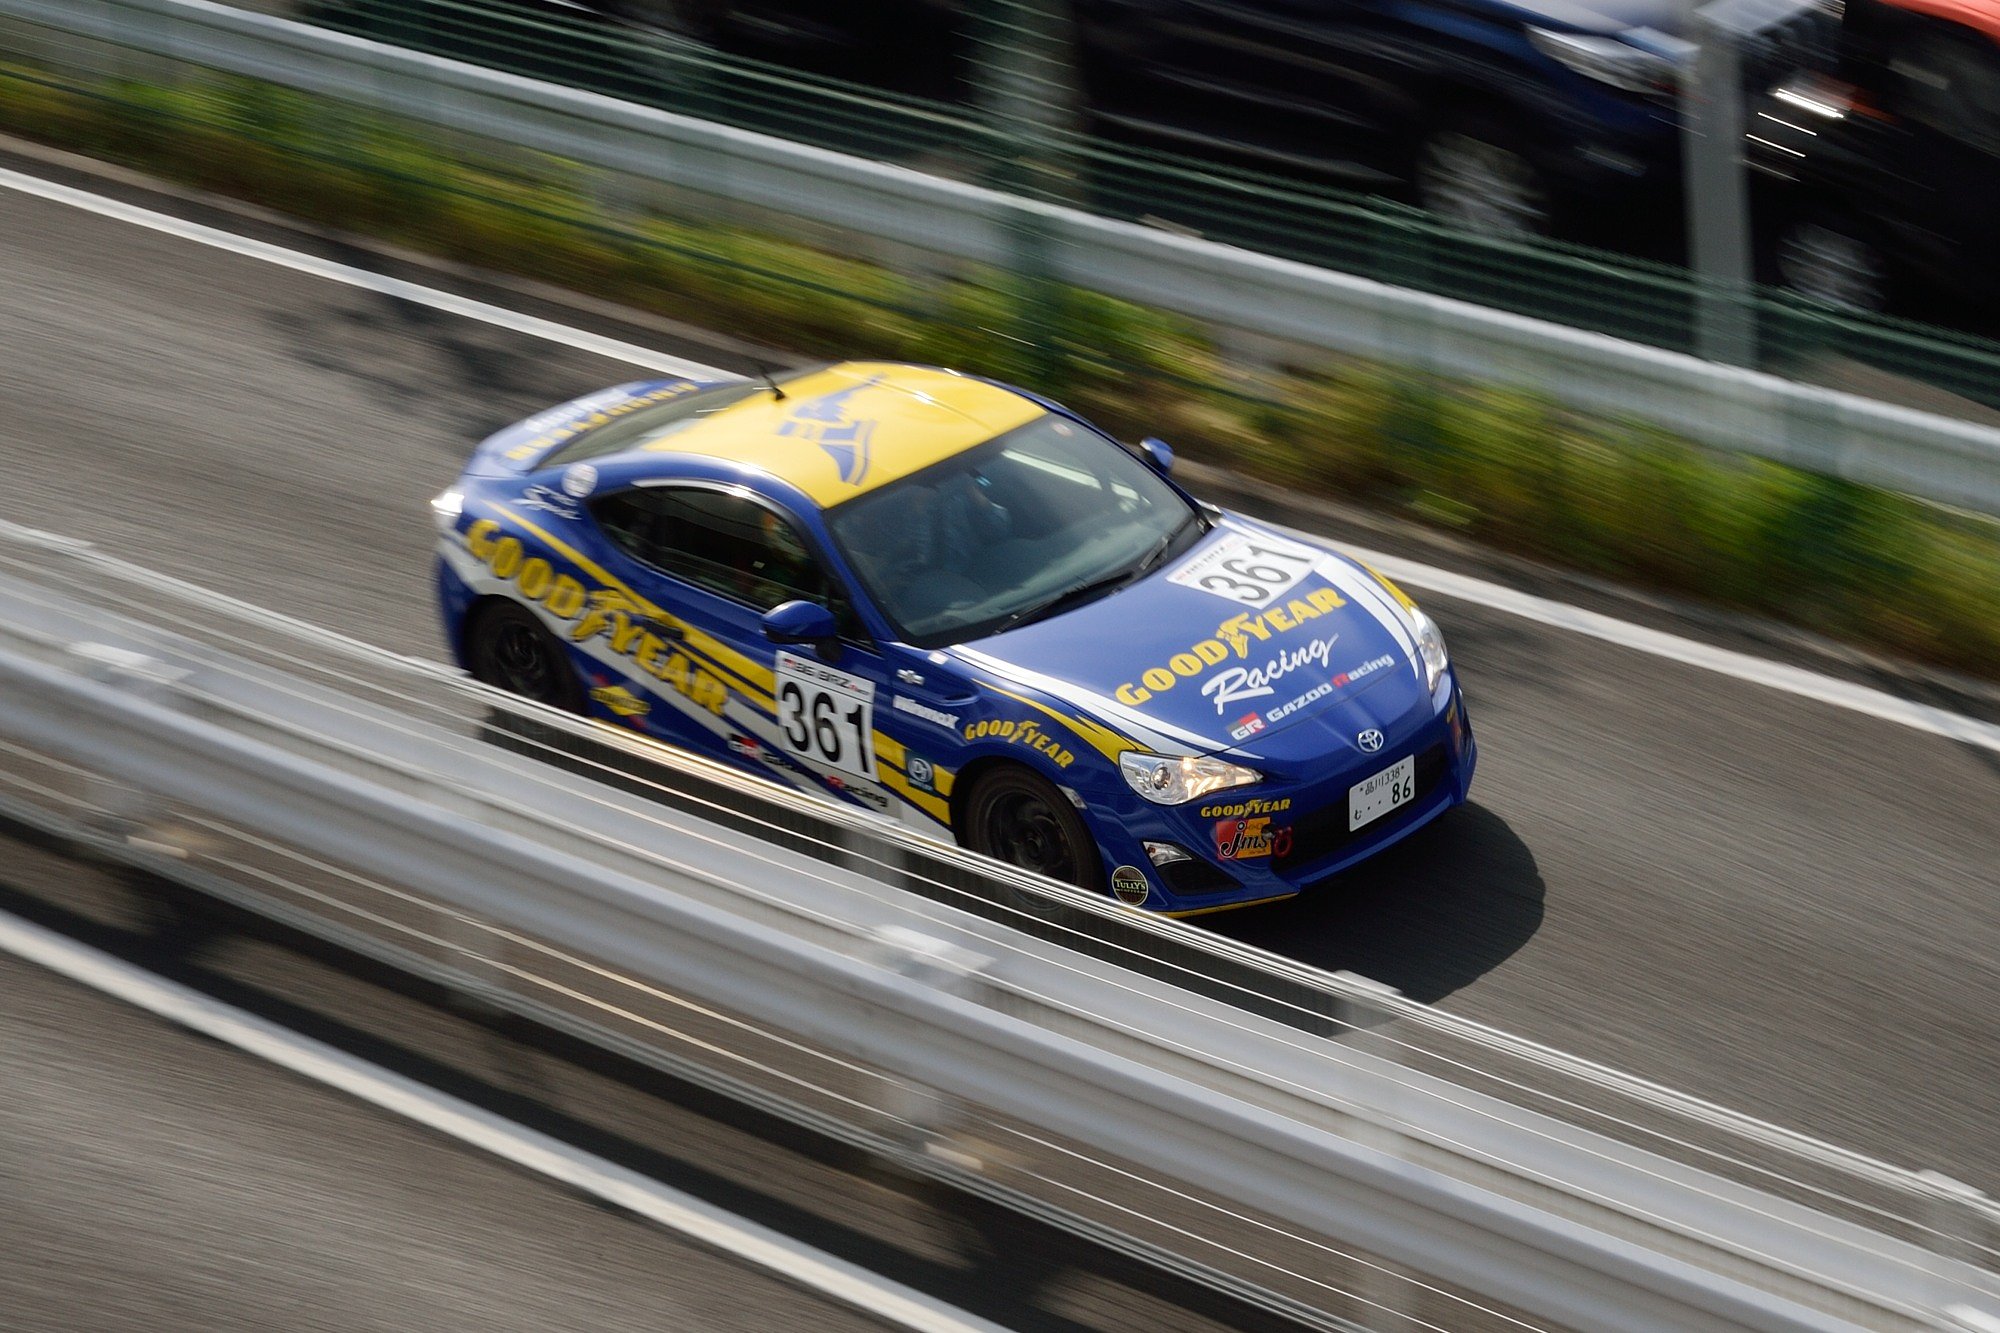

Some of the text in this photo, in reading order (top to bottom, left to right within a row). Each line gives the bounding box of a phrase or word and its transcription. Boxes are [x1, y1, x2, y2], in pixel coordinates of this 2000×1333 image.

[1200, 544, 1311, 602] 361
[467, 518, 730, 716] GOODYEAR
[1115, 587, 1347, 706] GOODYEAR
[1201, 633, 1339, 716] Racing
[1231, 653, 1396, 741] GR GAZOO Racing
[781, 681, 871, 774] 361
[964, 719, 1075, 769] GOODYEAR
[1200, 798, 1291, 818] GOODYEAR
[1392, 775, 1411, 804] 86
